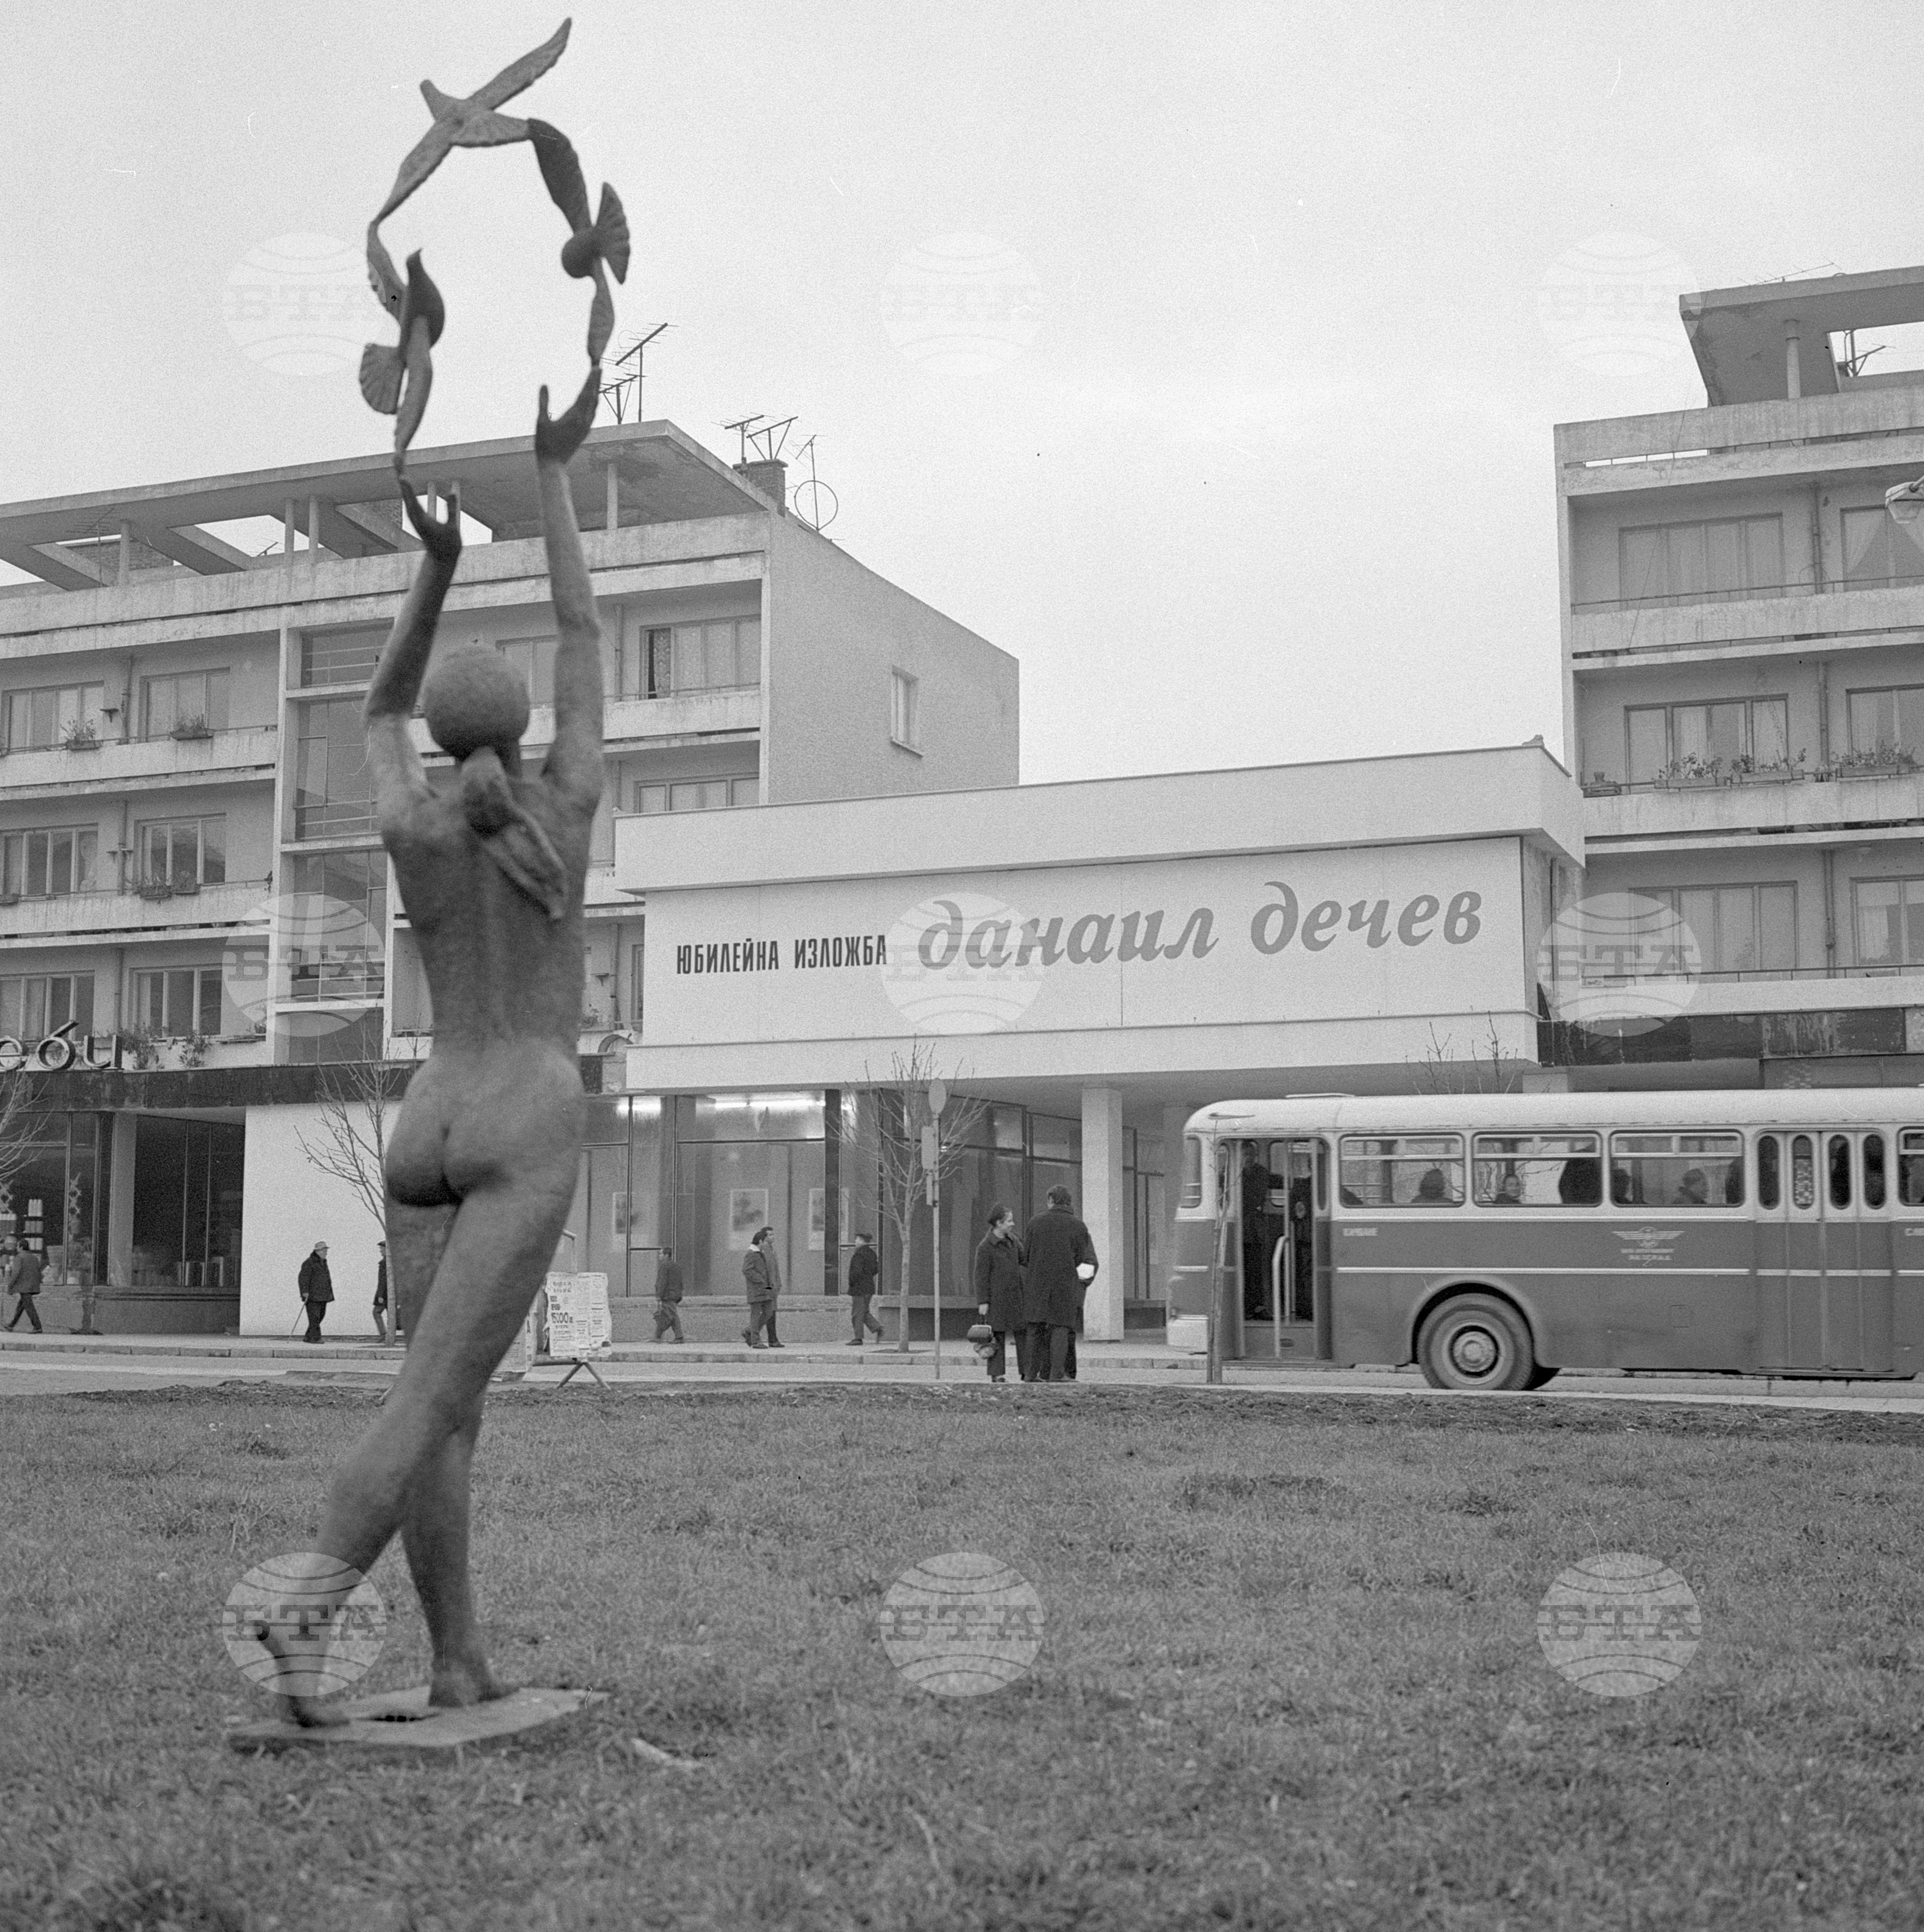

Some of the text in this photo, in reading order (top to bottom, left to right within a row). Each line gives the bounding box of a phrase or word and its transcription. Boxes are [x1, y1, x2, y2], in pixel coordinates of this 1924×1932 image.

[677, 881, 1482, 974] ЮБИЛЕЙНА ИЗЛОЖБА данаил дечев
